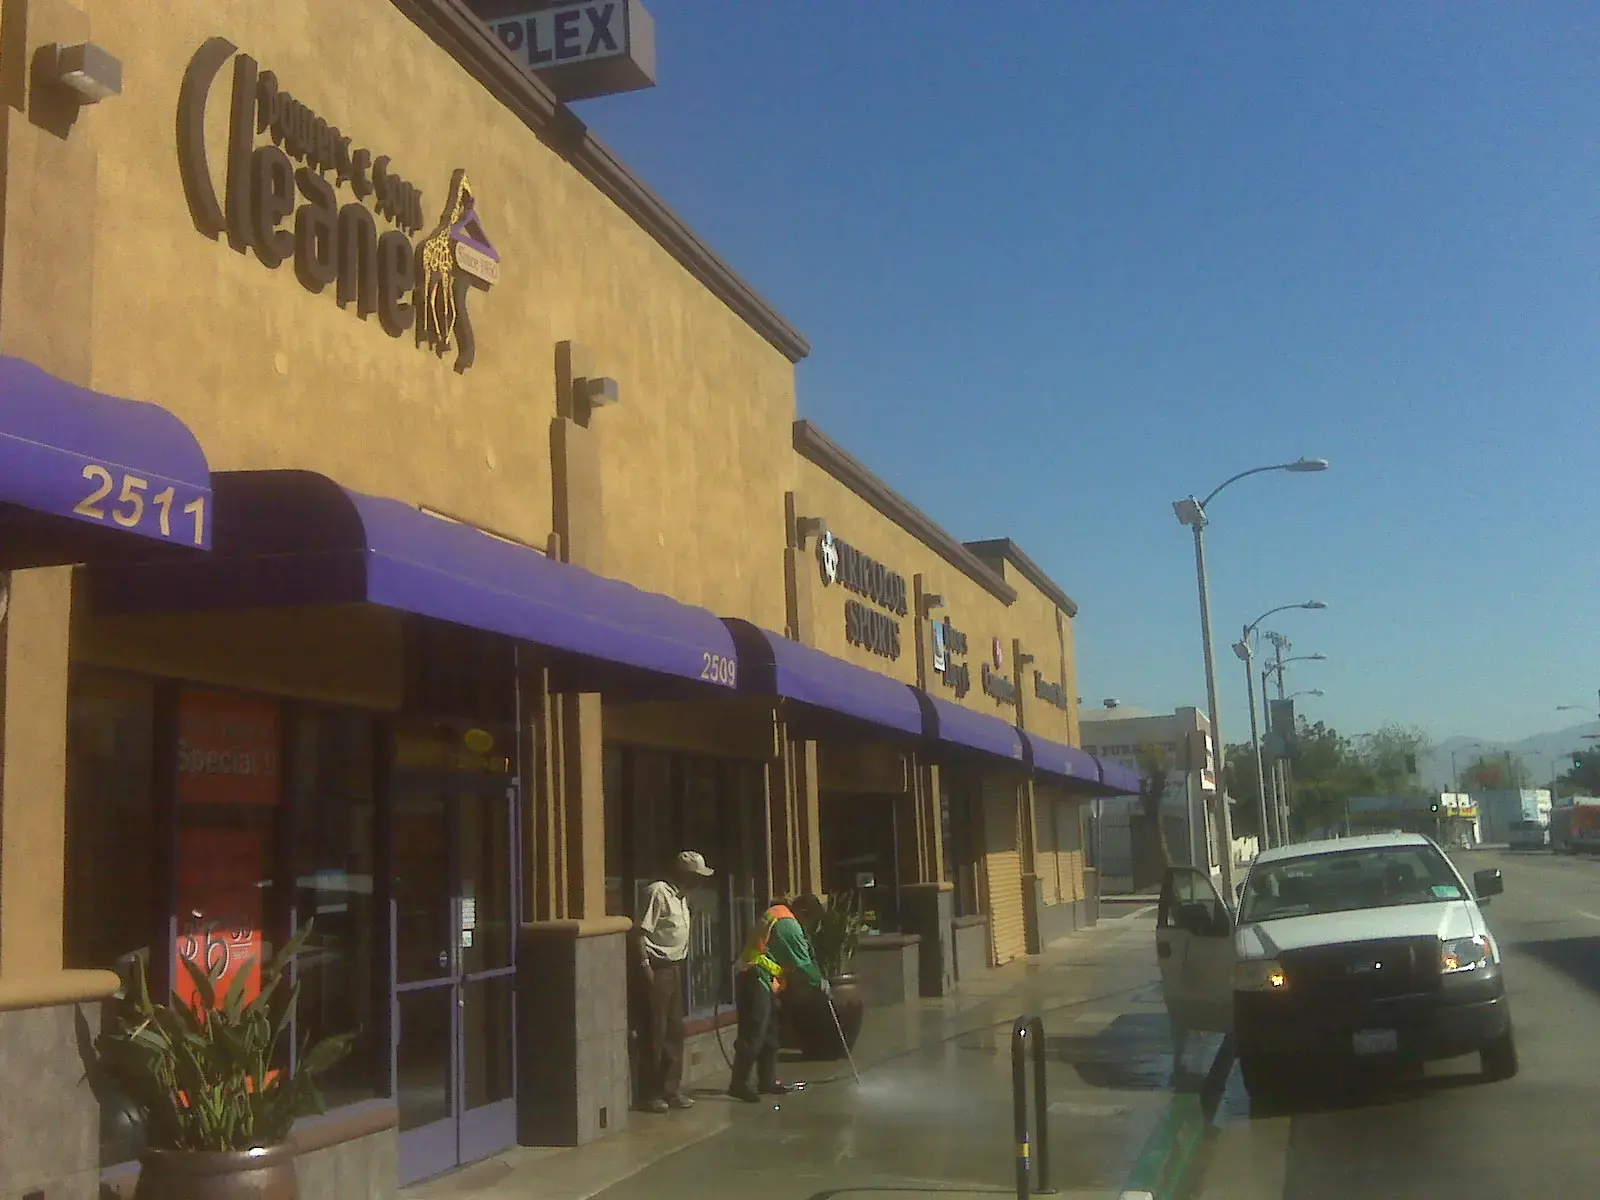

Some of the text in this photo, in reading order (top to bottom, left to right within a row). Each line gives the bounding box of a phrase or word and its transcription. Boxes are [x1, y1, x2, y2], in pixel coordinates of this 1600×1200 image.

[489, 4, 618, 64] PLEX
[72, 465, 207, 545] 2511
[845, 599, 901, 662] SPORTS
[700, 652, 737, 687] 2509
